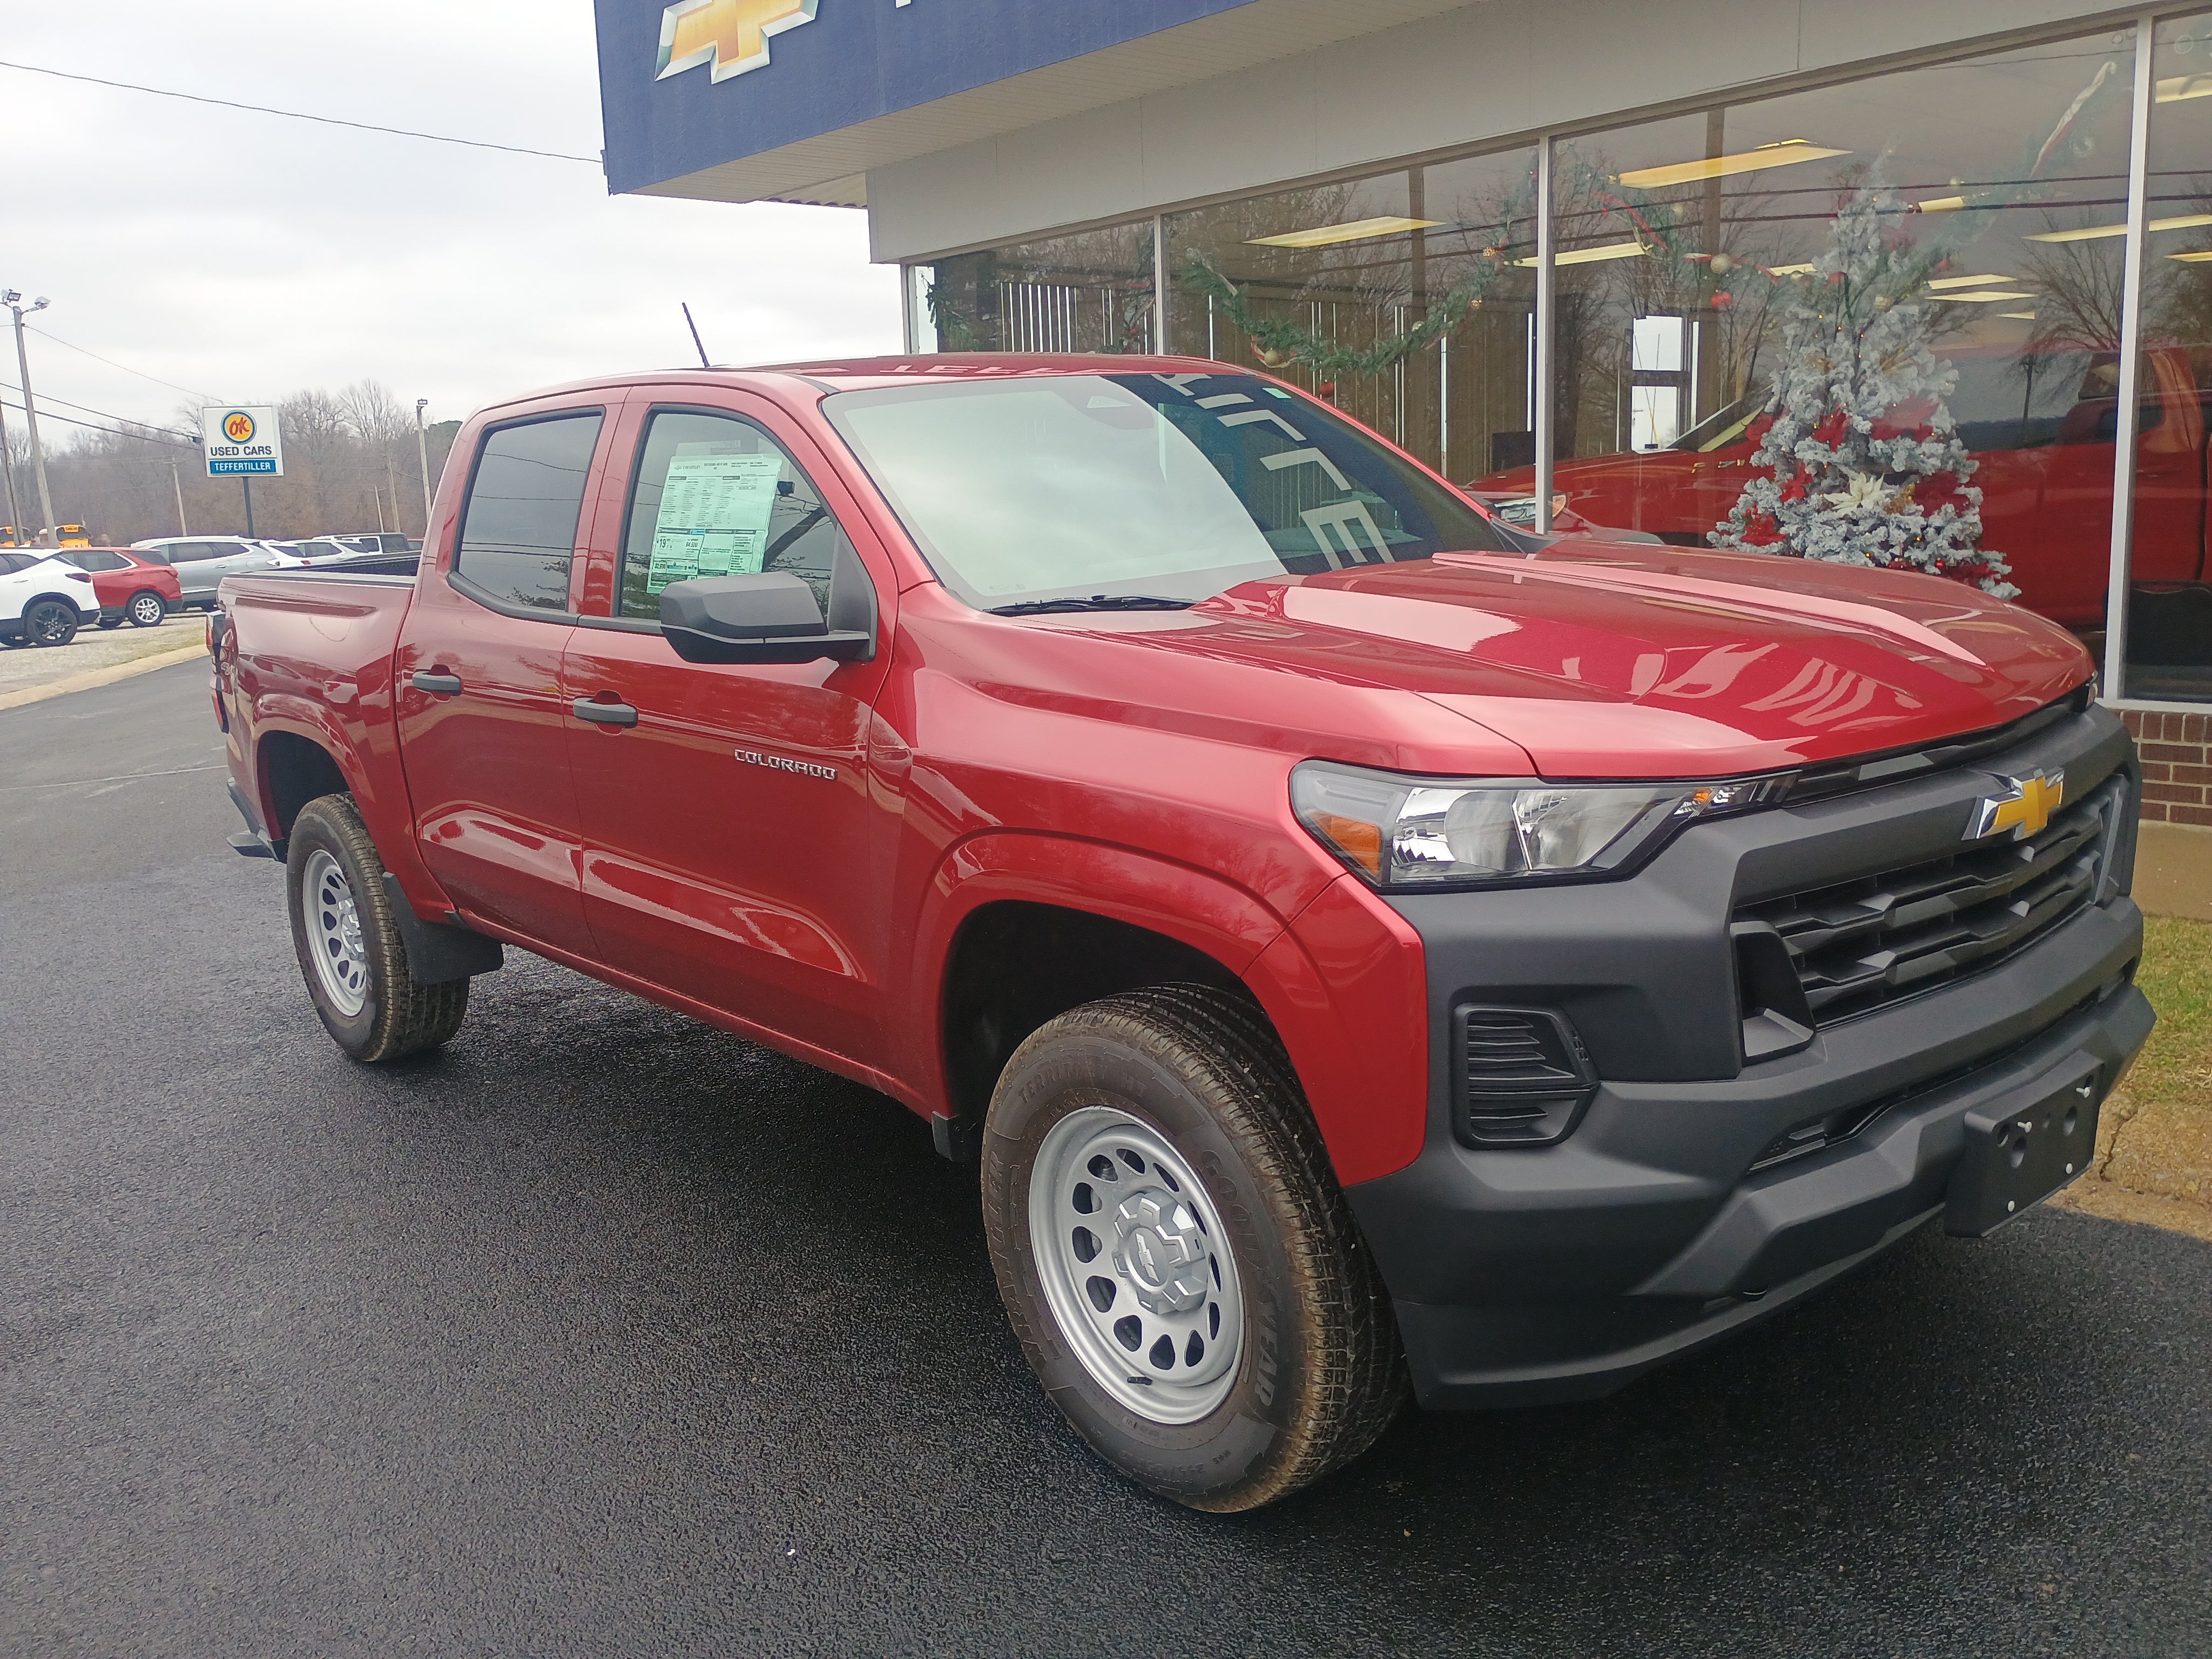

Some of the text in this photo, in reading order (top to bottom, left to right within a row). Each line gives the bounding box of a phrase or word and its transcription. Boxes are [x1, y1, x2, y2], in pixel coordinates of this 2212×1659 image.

[229, 417, 249, 436] OK
[210, 446, 272, 456] USED CARS
[214, 462, 271, 471] TEFFERTILLER
[735, 749, 837, 780] COLORADO
[1018, 1060, 1109, 1105] TERRITORY
